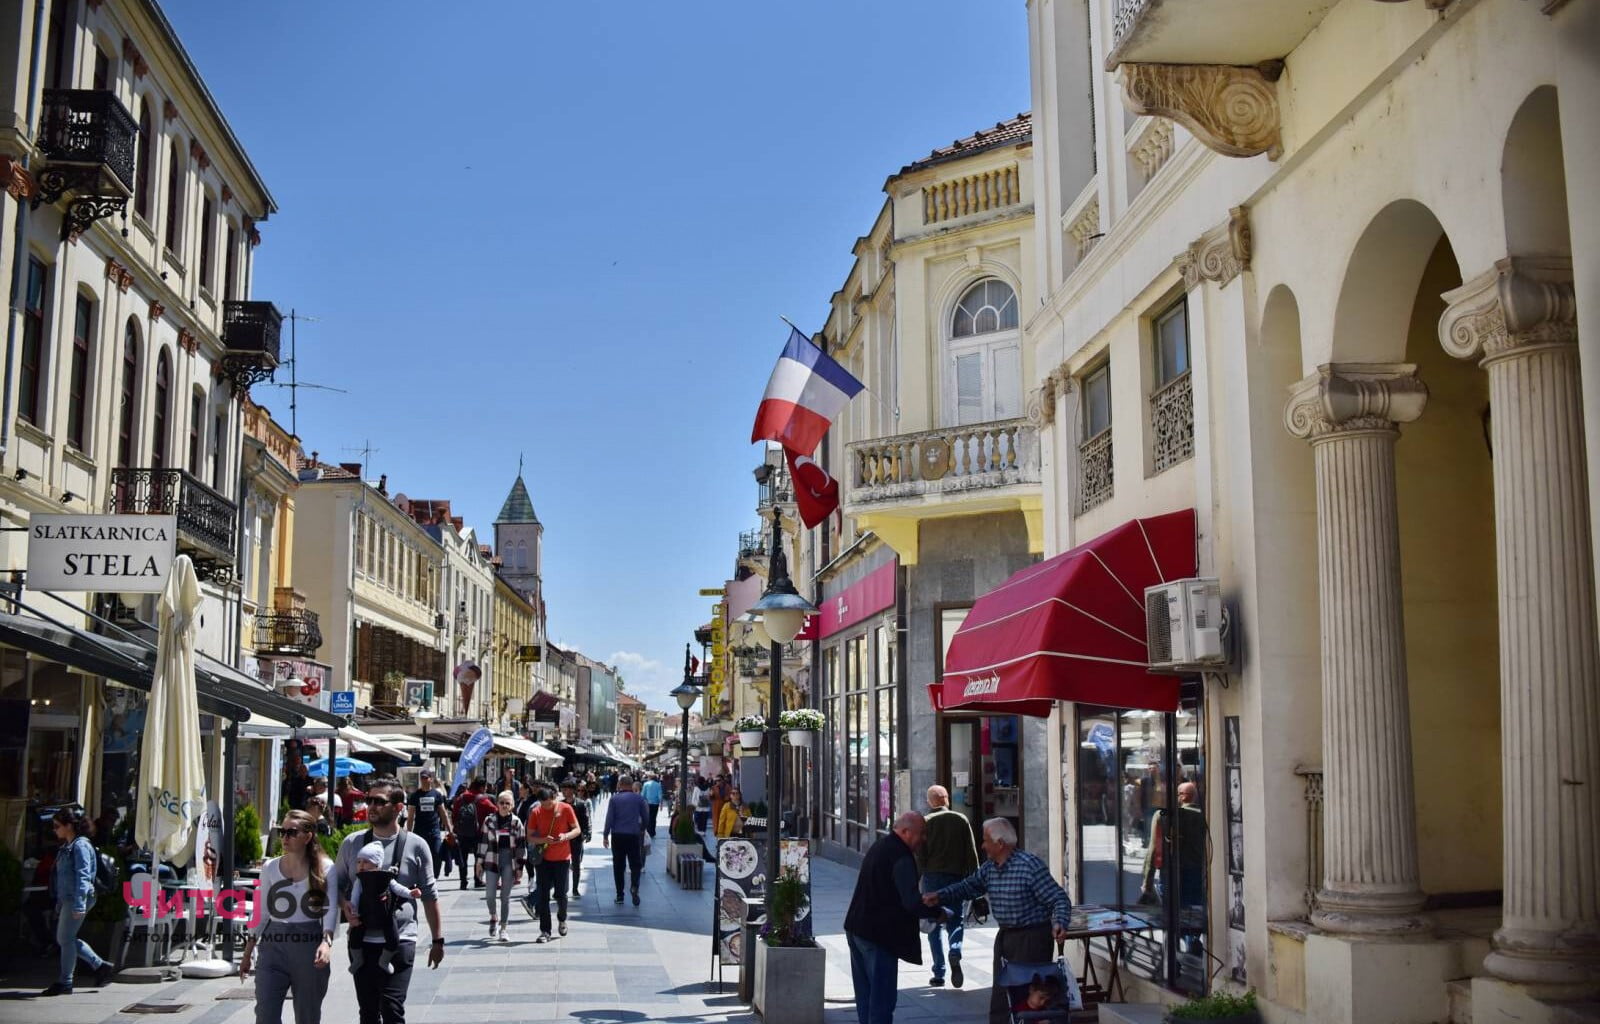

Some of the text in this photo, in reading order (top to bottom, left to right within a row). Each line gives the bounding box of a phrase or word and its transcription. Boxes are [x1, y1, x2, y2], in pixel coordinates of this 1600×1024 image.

[33, 525, 168, 541] SLATKARNICA
[63, 553, 160, 577] STELA
[746, 816, 768, 827] COFFEE
